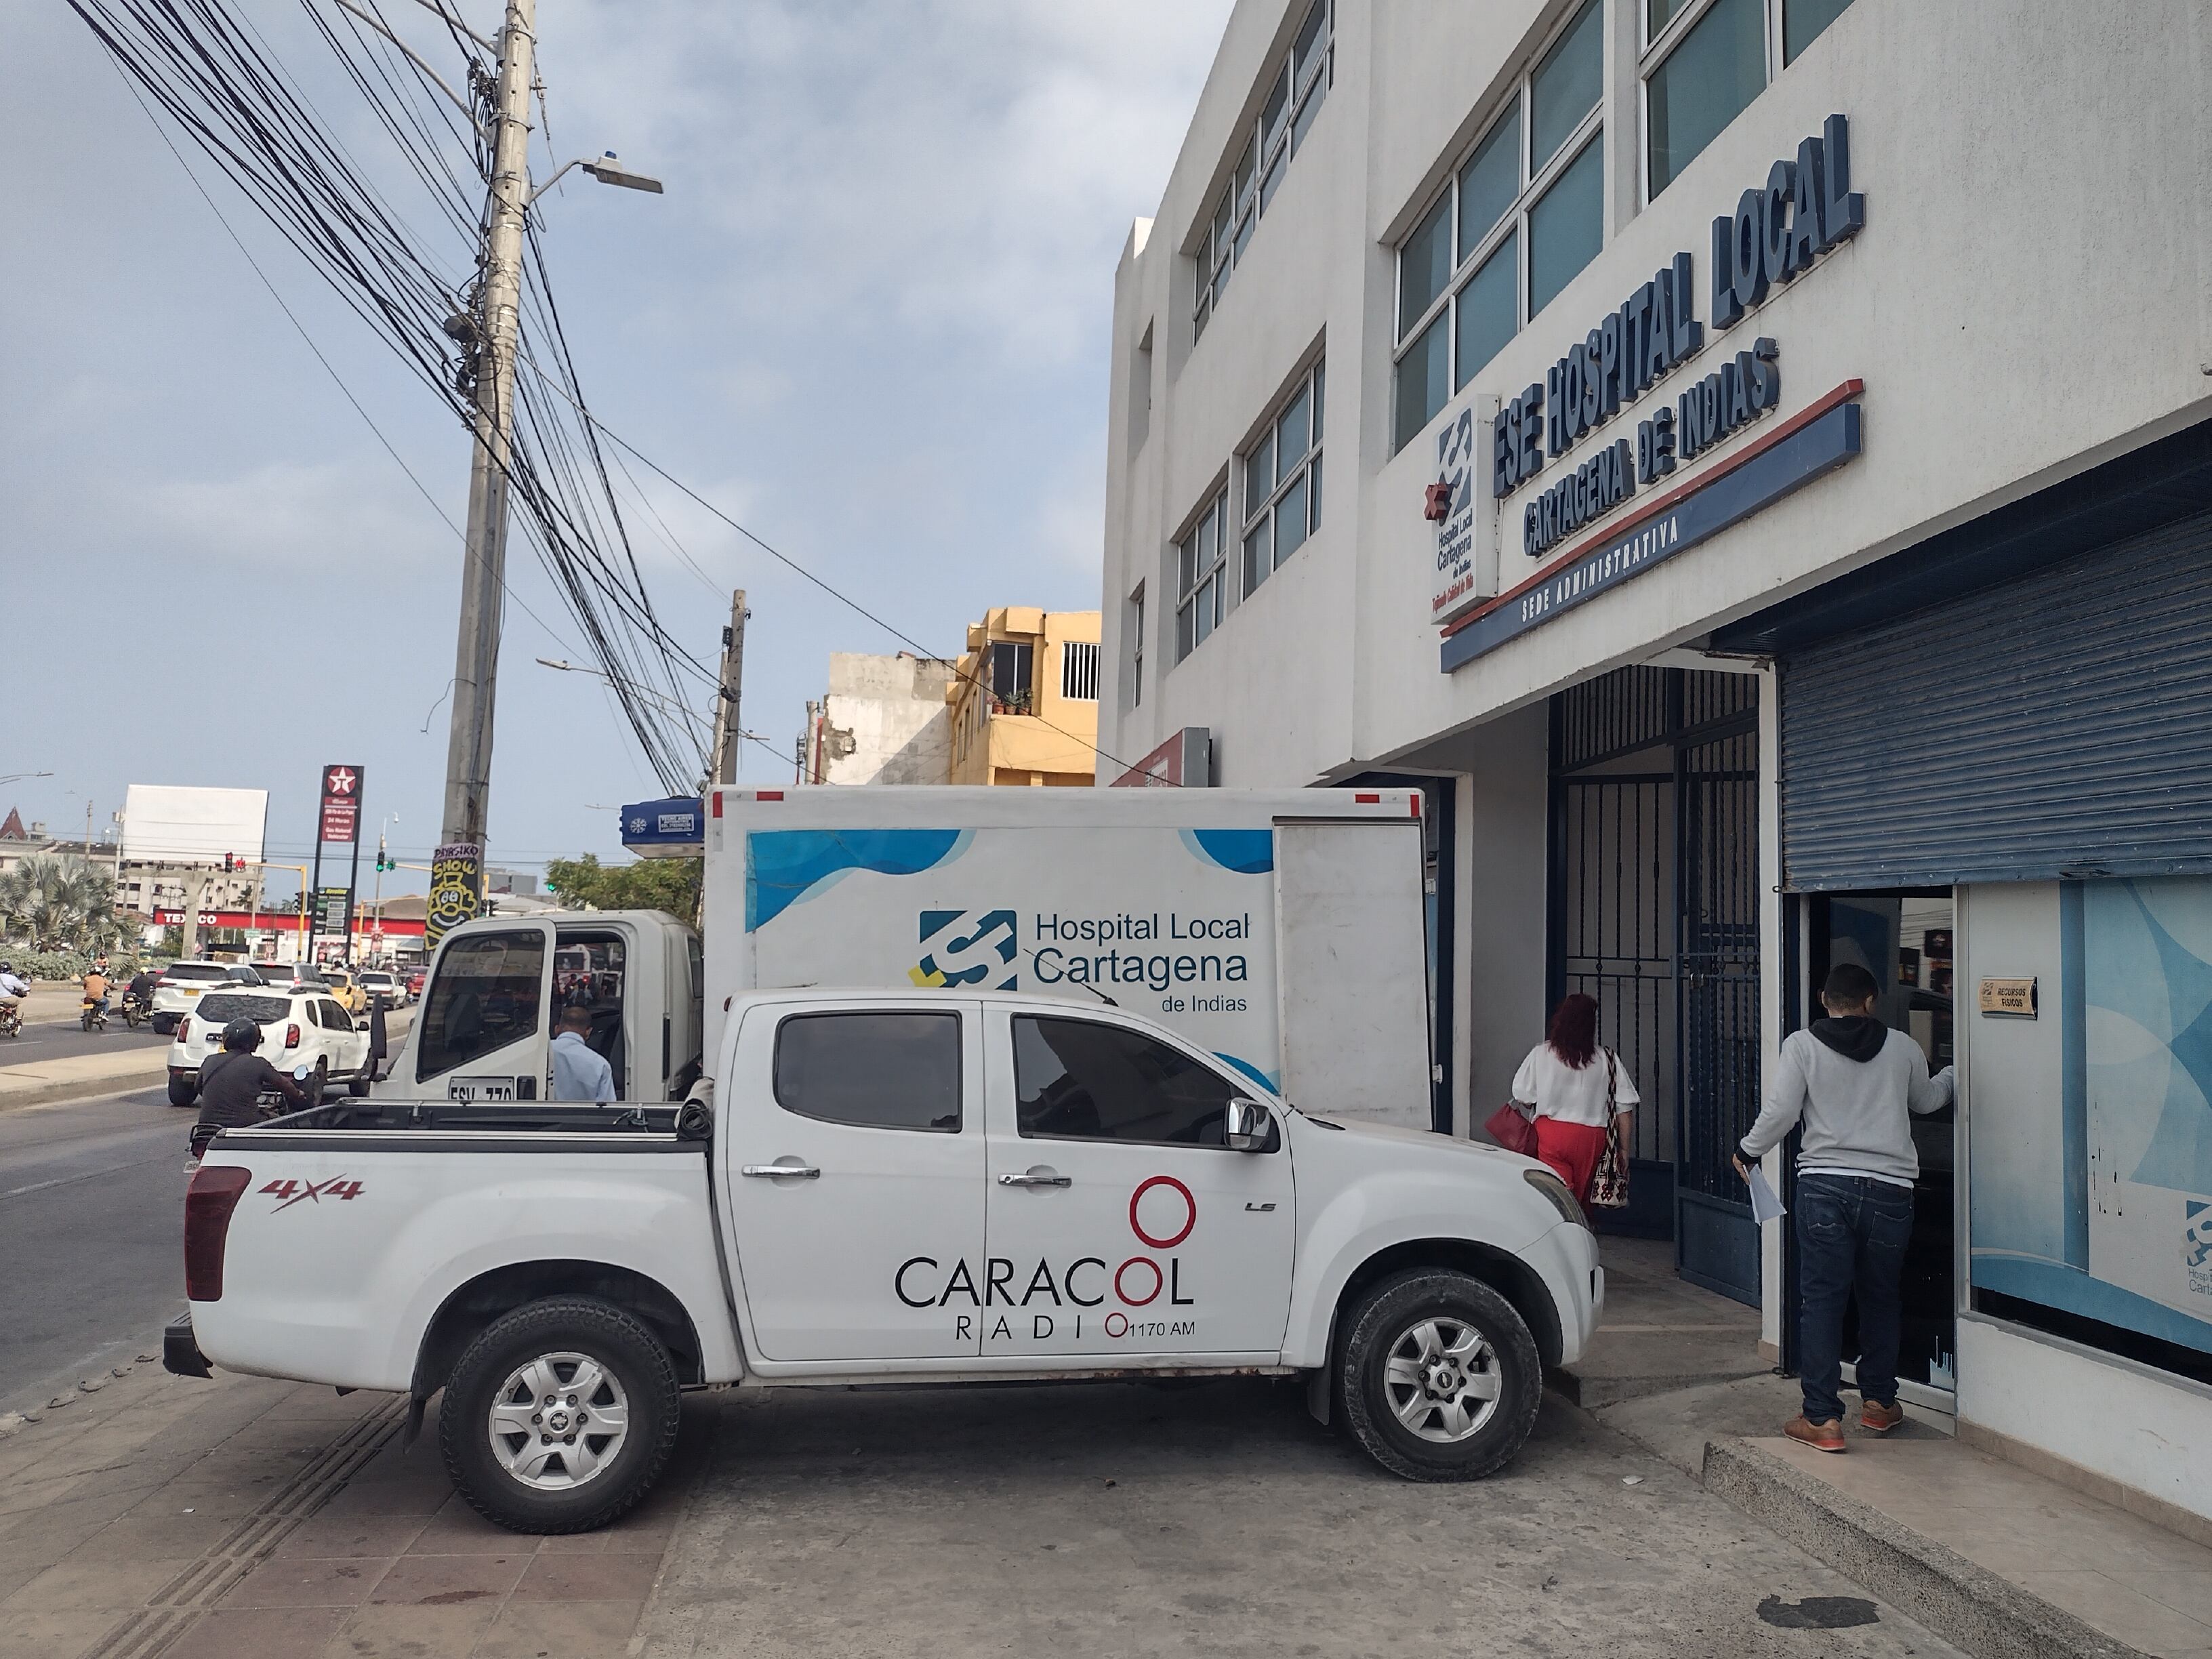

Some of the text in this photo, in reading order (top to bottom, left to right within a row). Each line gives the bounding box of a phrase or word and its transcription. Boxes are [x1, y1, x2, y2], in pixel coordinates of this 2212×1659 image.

[1494, 113, 1866, 499] ESE HOSPITAL LOCAL
[1523, 336, 1781, 556] CARTAGENA DE INDIAS
[1438, 508, 1473, 550] Hospital Local
[1437, 533, 1472, 571] Cartagena
[1522, 516, 1678, 622] SEDE ADMINISTRATIVA
[433, 859, 477, 880] SHOW
[434, 844, 478, 859] PAYASIKO
[164, 913, 218, 924] TEXCO
[1036, 912, 1249, 947] Hospital Local
[1033, 947, 1248, 992] Cartagena
[1162, 995, 1248, 1012] de Indias
[1997, 987, 2026, 997] RECURSOS
[895, 1256, 1195, 1308] CARACOL
[956, 1312, 1195, 1340] RADIO 1170 AM
